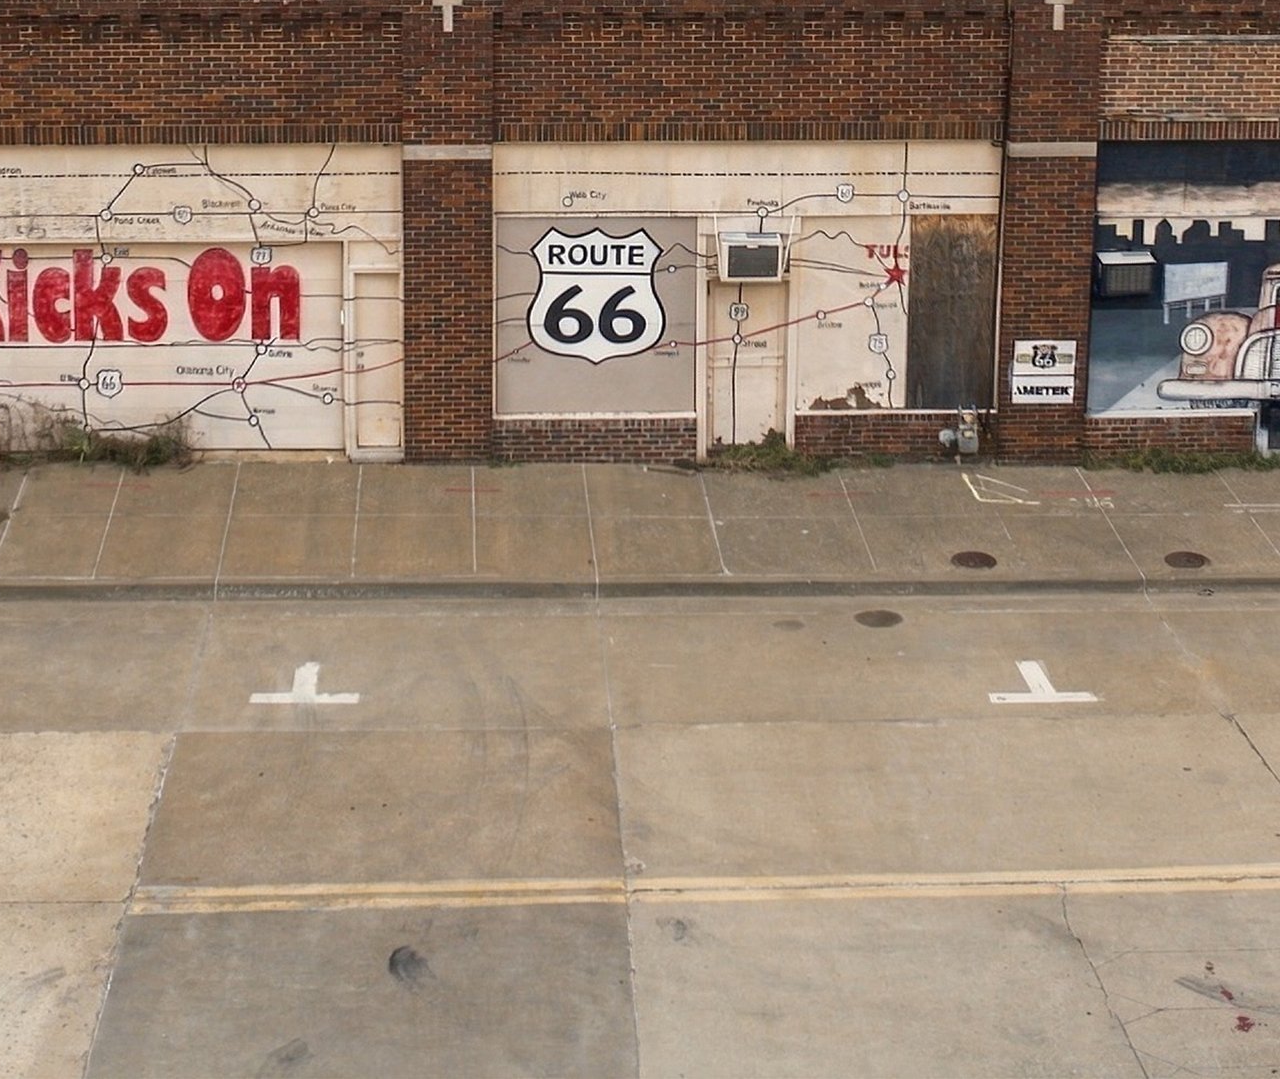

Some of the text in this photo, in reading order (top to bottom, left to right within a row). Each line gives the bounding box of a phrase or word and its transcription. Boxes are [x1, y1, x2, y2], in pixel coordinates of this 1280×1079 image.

[548, 244, 644, 266] ROUTE
[188, 247, 301, 342] On
[544, 284, 647, 344] 66
[102, 376, 116, 391] 66
[1014, 386, 1071, 396] AMETEK
